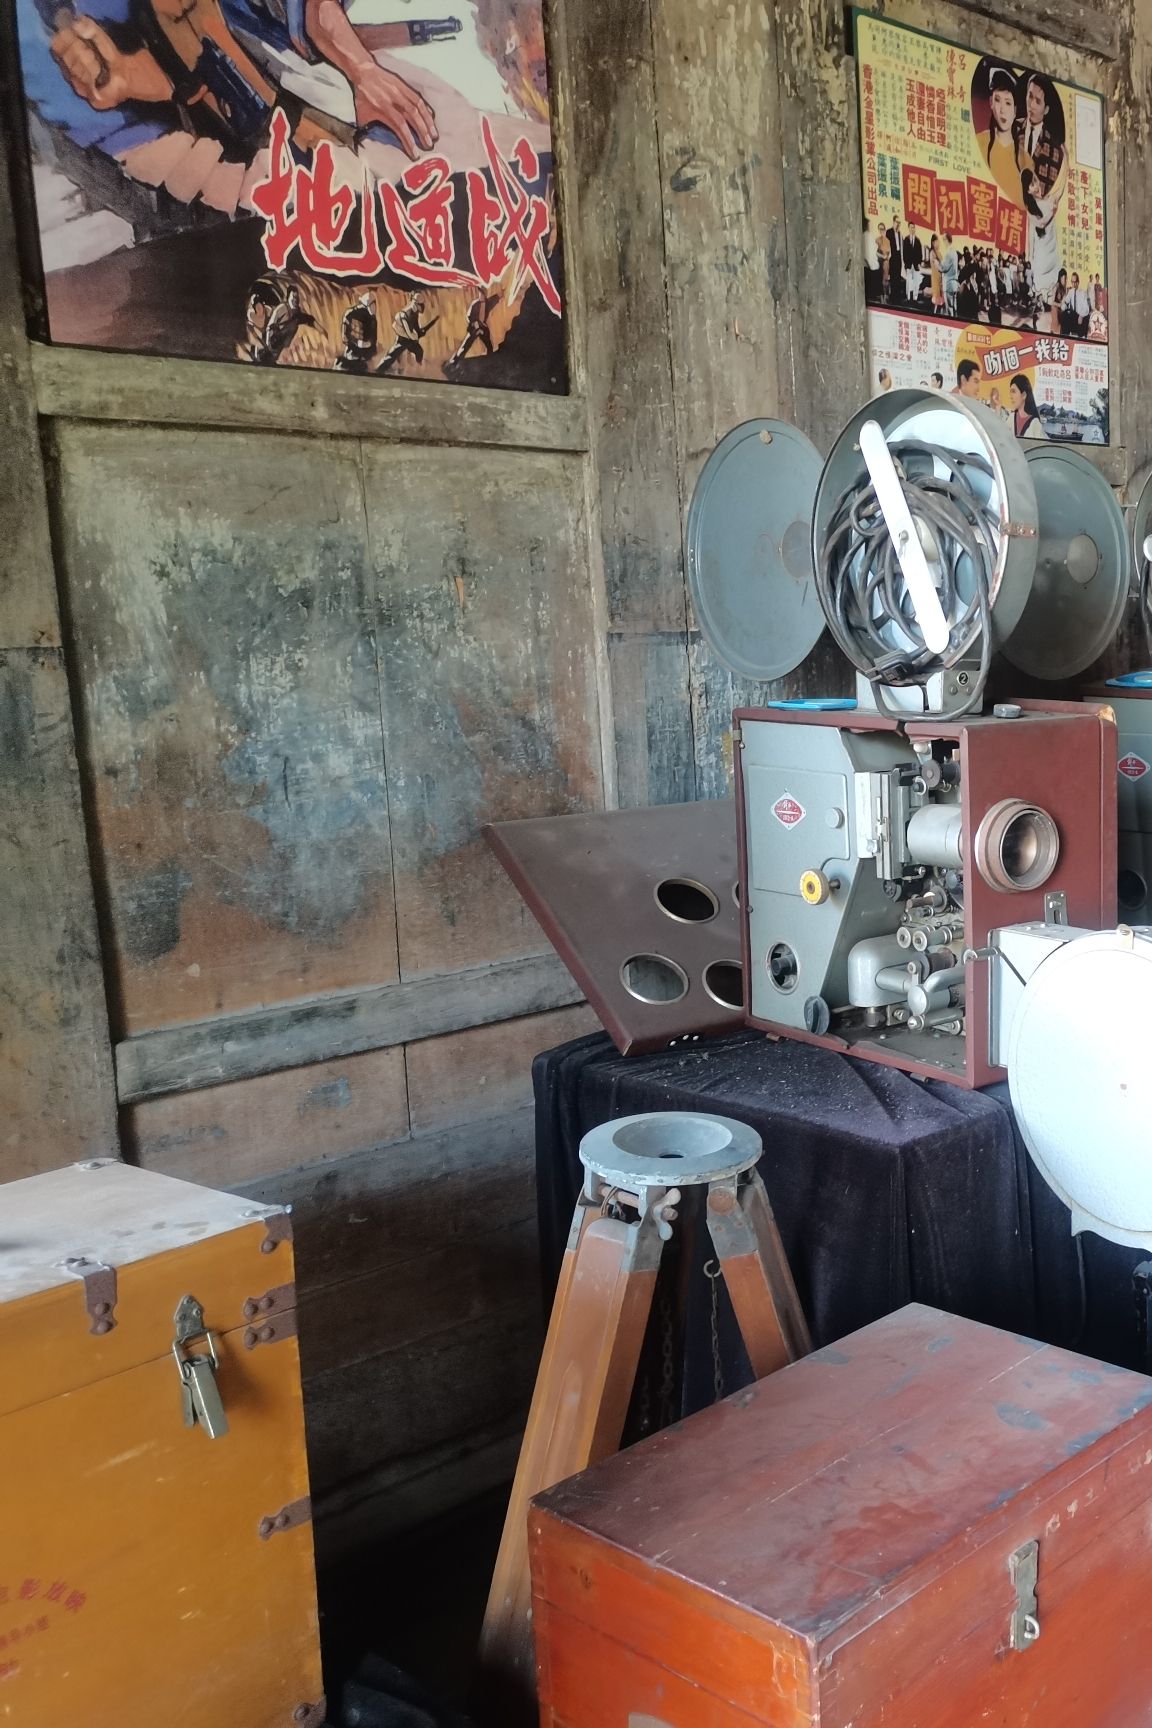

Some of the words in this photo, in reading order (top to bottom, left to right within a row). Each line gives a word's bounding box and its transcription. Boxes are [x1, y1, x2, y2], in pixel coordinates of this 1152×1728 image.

[252, 107, 561, 317] 地道战
[928, 155, 949, 168] FIRST
[953, 162, 971, 175] LOVE
